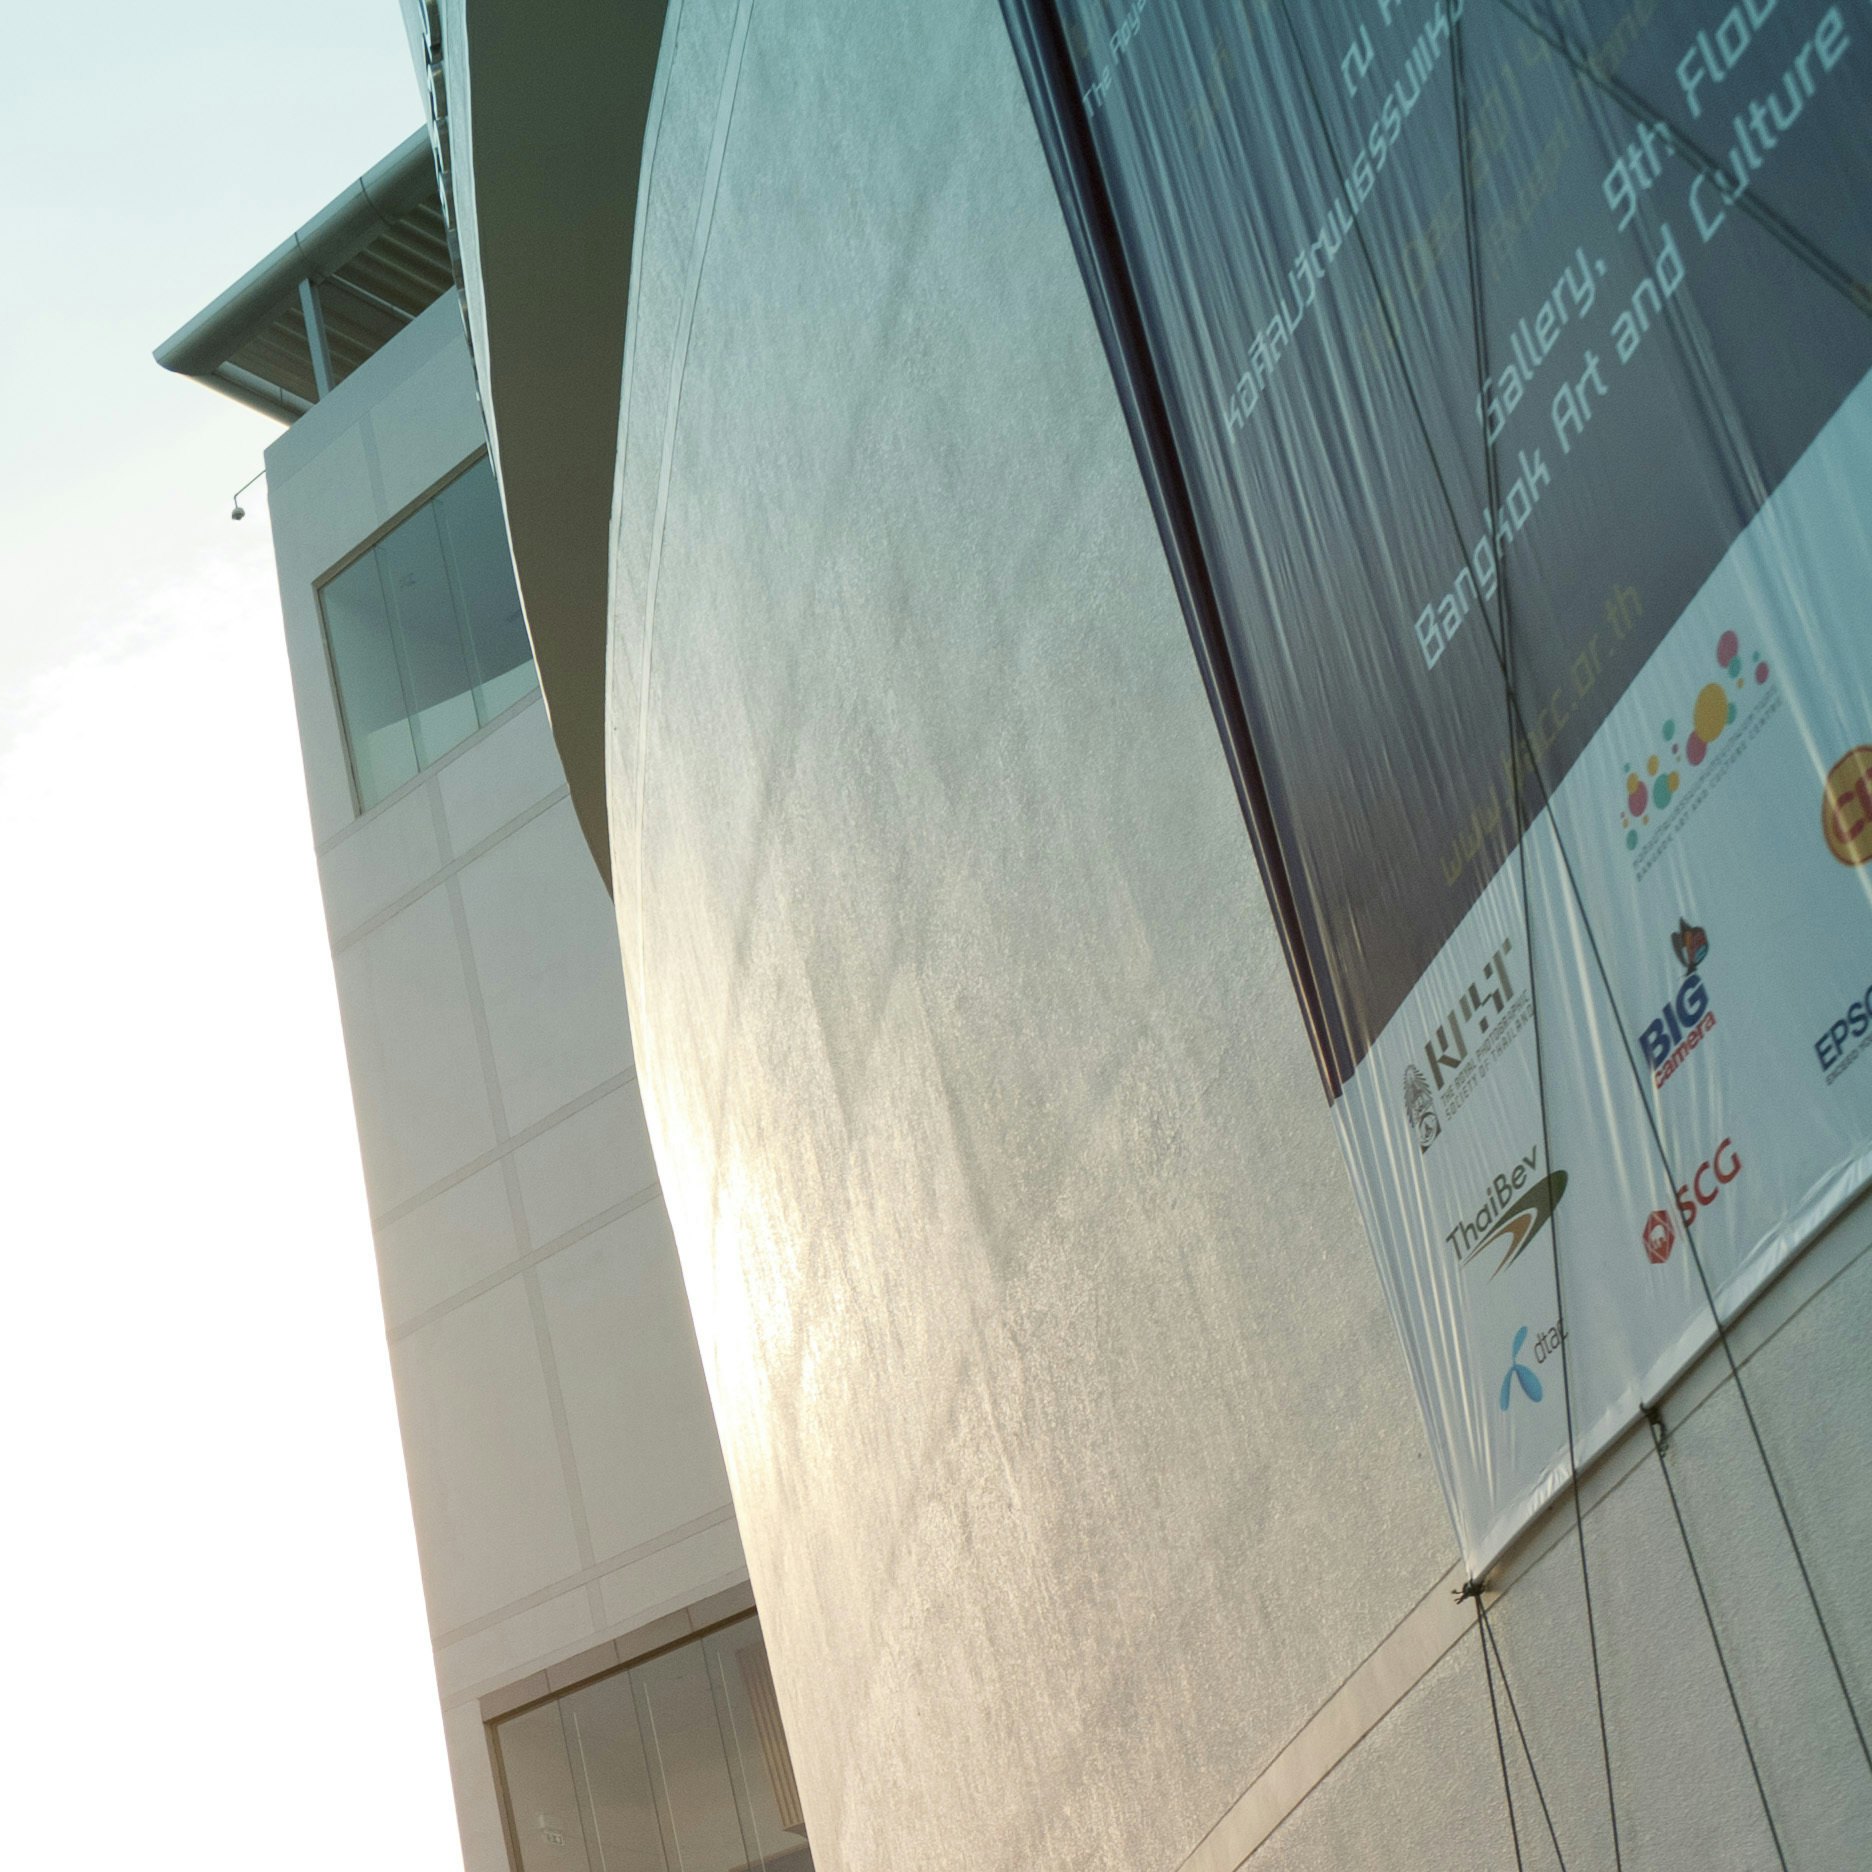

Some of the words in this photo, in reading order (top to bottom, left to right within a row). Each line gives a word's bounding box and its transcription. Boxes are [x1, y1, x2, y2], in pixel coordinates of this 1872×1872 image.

[1083, 65, 1112, 117] The
[1474, 245, 1608, 448] Gallery,
[1601, 120, 1675, 233] 9th
[1414, 447, 1552, 671] Bangkok
[1550, 349, 1609, 454] Art
[1610, 222, 1686, 366] and
[1688, 4, 1850, 244] Culture
[1440, 1085, 1456, 1106] THE
[1454, 1058, 1477, 1087] ROYAL
[1476, 989, 1529, 1062] PHOTOGRAPHIC
[1445, 1075, 1478, 1121] SOCIETY
[1479, 1059, 1492, 1079] OF
[1491, 1003, 1534, 1064] THAILAND
[1638, 974, 1709, 1069] BIG
[1655, 1010, 1717, 1089] camera
[1446, 1144, 1537, 1261] ThaiBev
[1676, 1136, 1743, 1229] SCG
[1534, 1316, 1569, 1366] dtac
